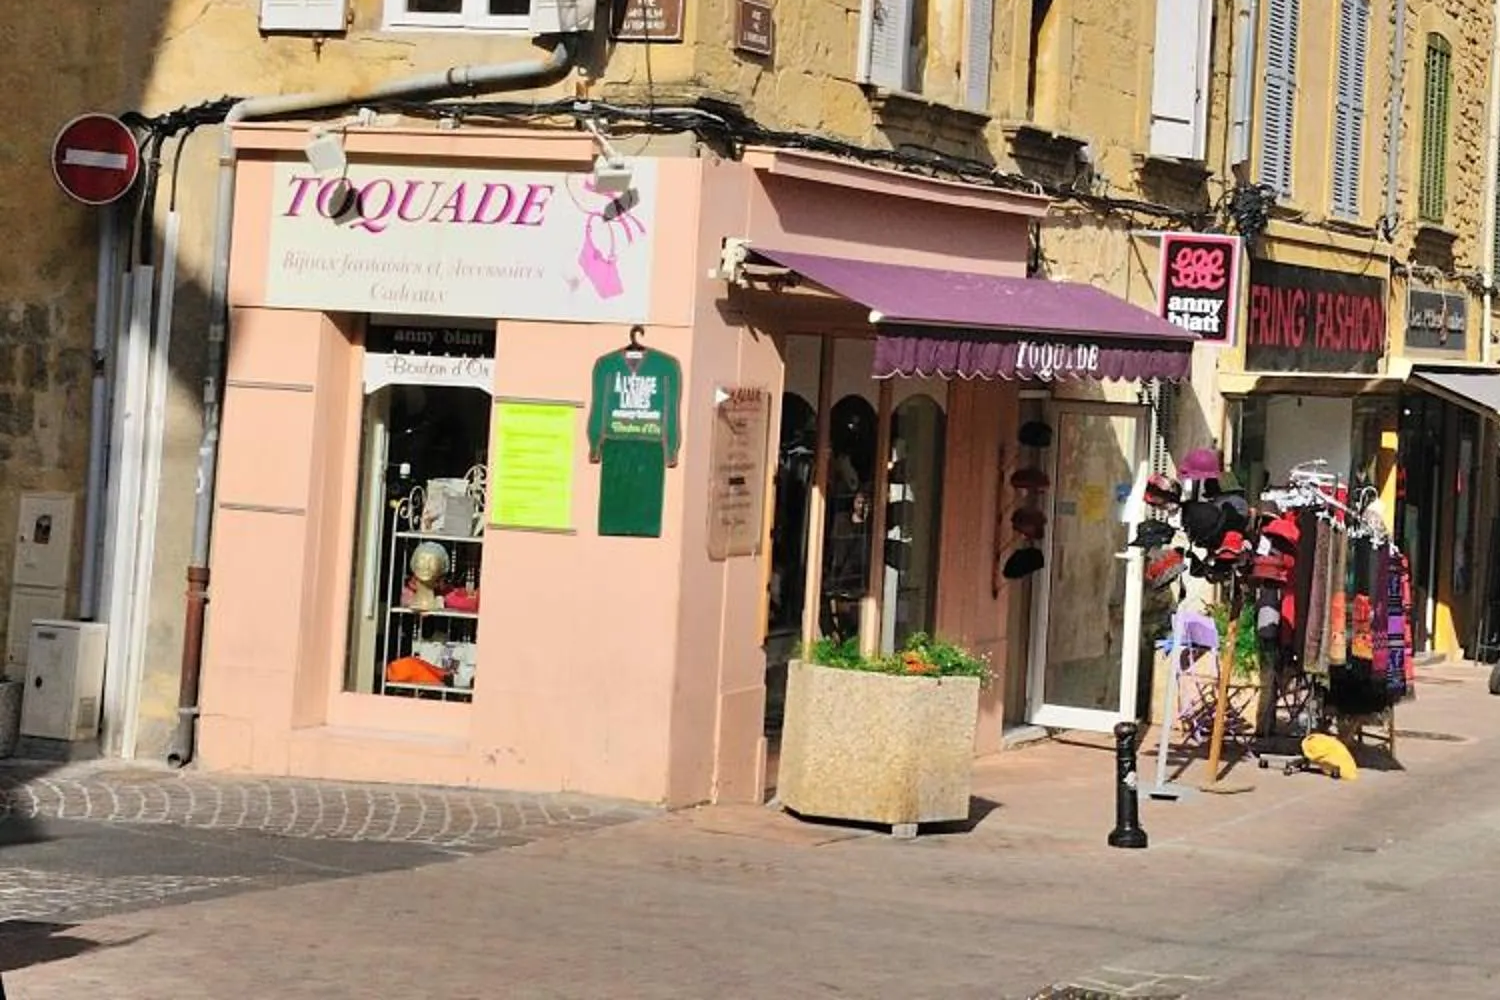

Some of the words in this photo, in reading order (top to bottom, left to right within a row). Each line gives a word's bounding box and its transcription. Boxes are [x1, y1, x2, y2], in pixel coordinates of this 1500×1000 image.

[283, 174, 554, 233] TOQUADE
[1168, 296, 1225, 316] anny
[1168, 311, 1220, 333] blatt
[1315, 291, 1384, 353] FASHION
